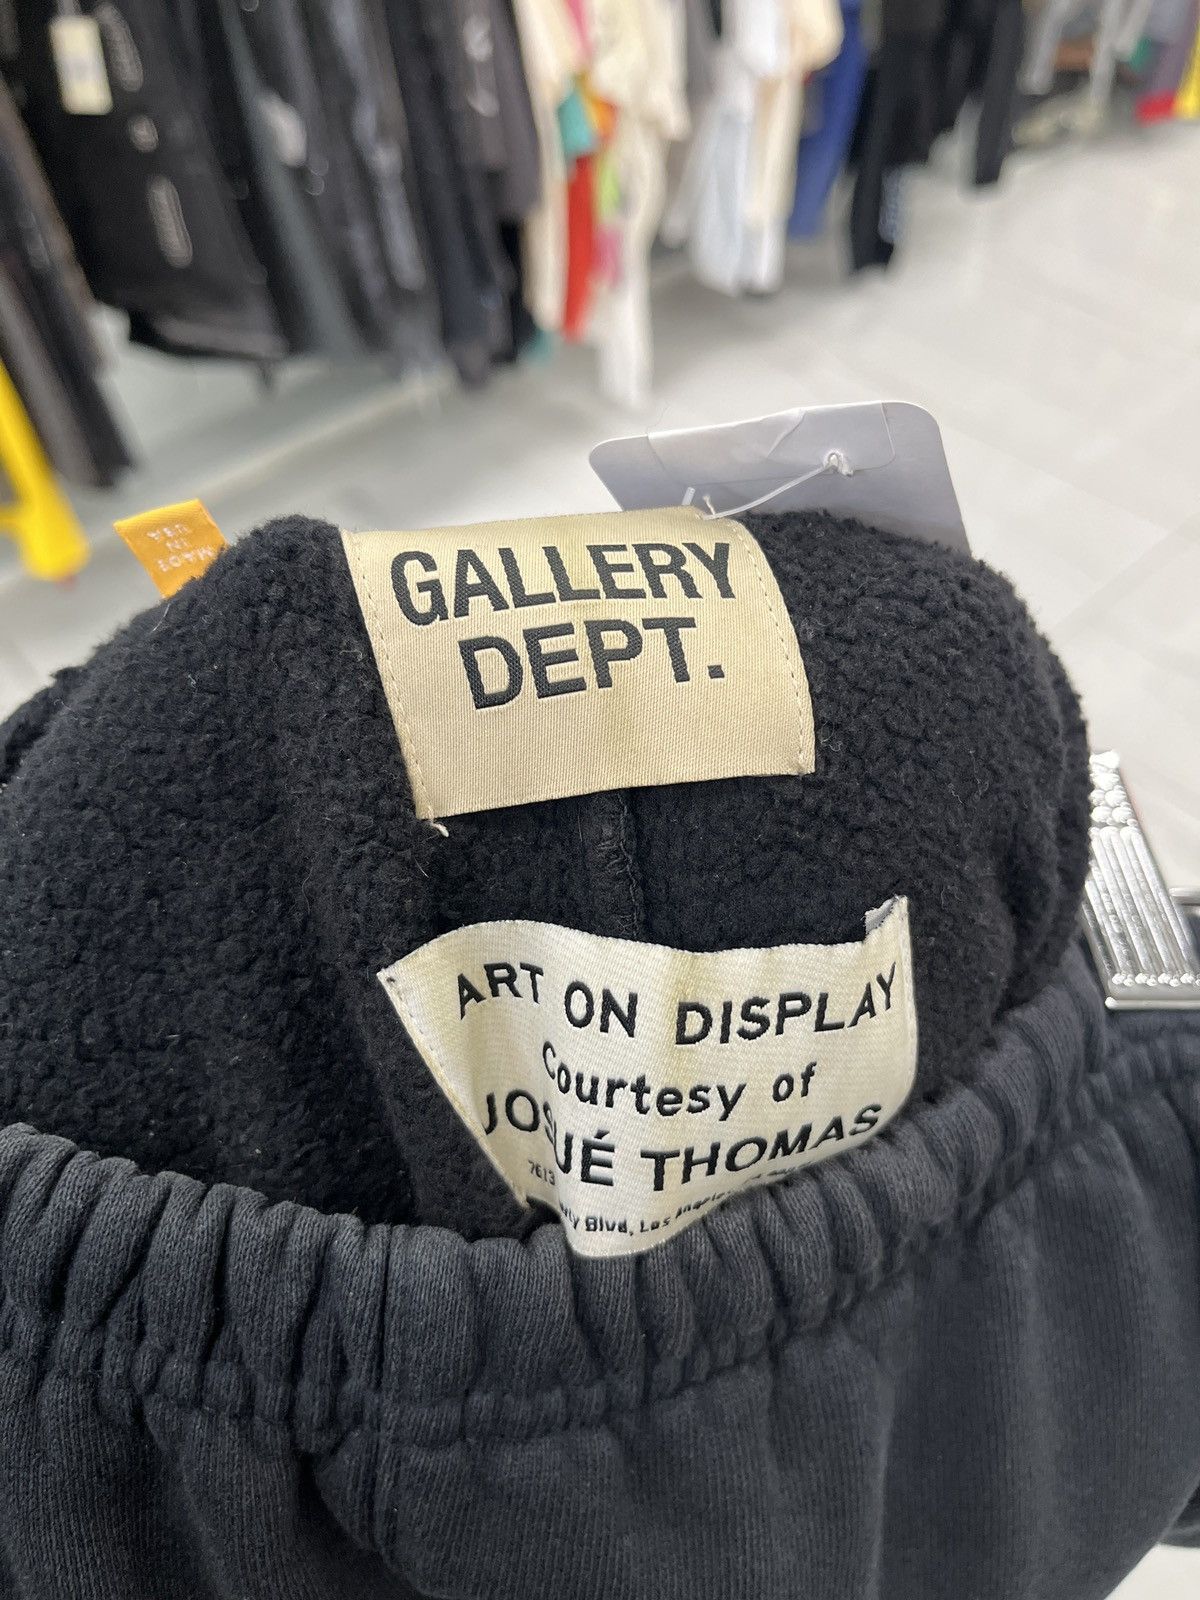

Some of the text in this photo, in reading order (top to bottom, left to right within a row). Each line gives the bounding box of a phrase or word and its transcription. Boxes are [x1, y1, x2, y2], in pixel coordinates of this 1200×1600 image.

[390, 541, 737, 626] GALLERY
[457, 616, 726, 710] DEPT.
[457, 961, 897, 1045] ART ON DISPLAY
[542, 1040, 818, 1122] Courtesy of
[480, 1088, 882, 1192] JOSUÉ THOMAS
[584, 1215, 634, 1237] Blvd,
[639, 1216, 670, 1233] Los
